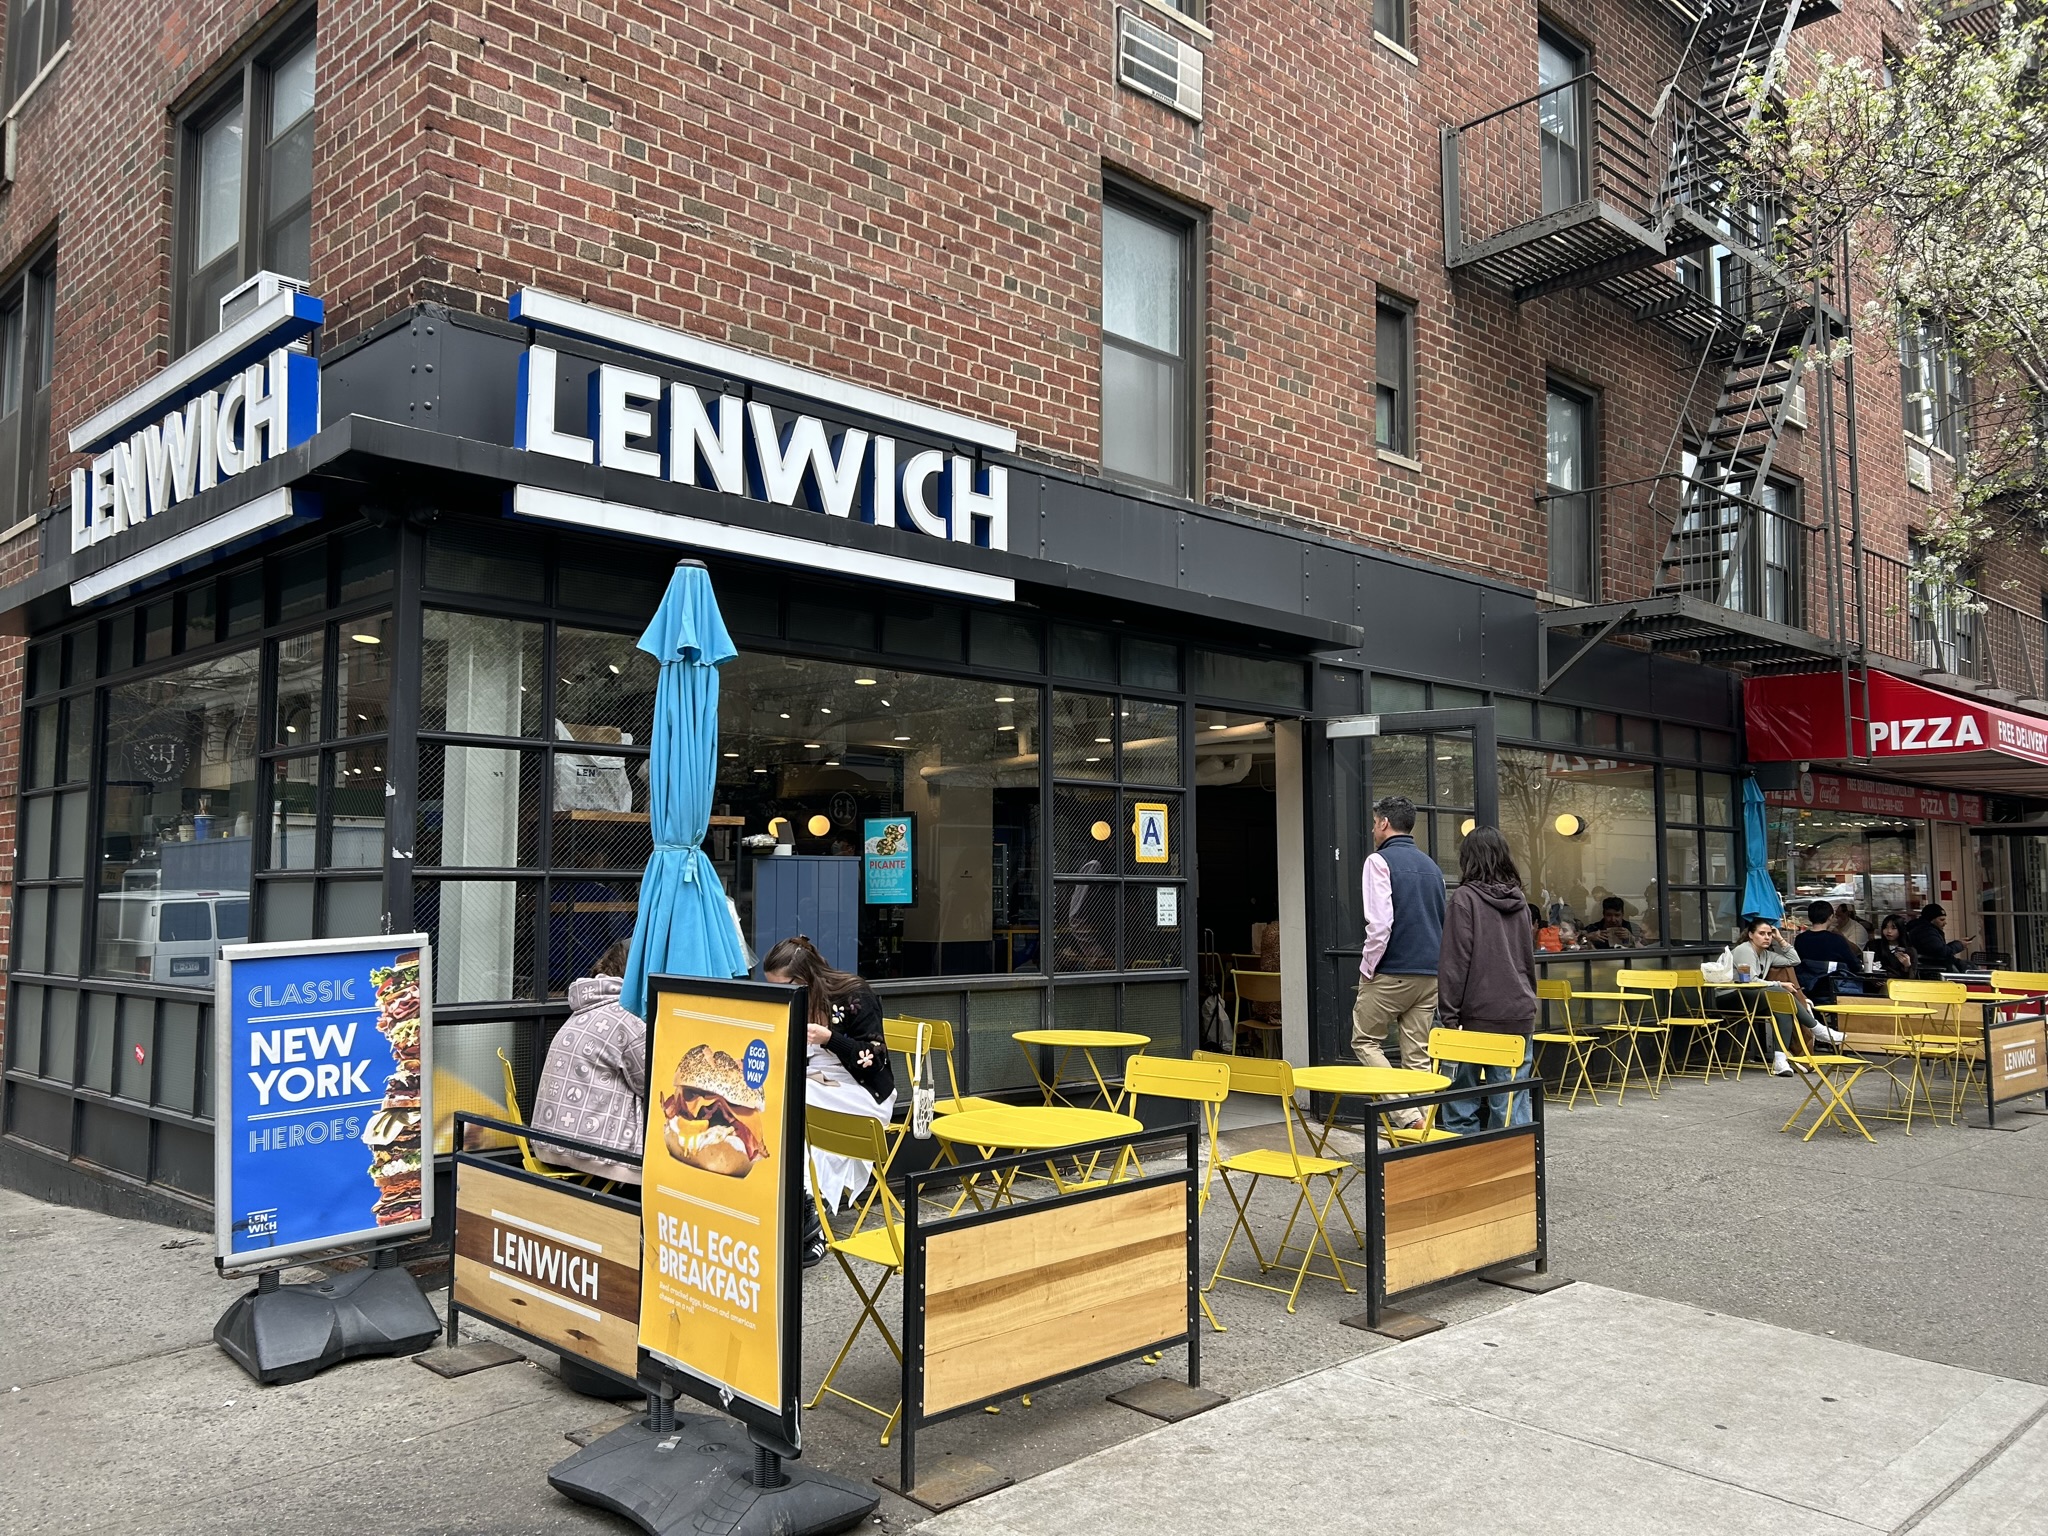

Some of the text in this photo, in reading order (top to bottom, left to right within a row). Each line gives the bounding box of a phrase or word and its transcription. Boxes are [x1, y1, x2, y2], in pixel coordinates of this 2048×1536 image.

[71, 348, 288, 554] LENWICH
[523, 344, 1008, 552] LENWICH
[1870, 715, 1983, 751] PIZZA
[1998, 720, 2048, 754] FREE DELIVERY
[1920, 797, 1945, 816] PIZZA
[1142, 816, 1161, 845] A
[869, 860, 906, 869] PICANTE
[869, 869, 904, 879] CAESAR
[869, 878, 898, 888] WRAP
[248, 978, 355, 1008] CLASSIC
[251, 1022, 358, 1067] NEW
[749, 1046, 766, 1059] EGGS
[747, 1058, 766, 1071] YOUR
[2004, 1048, 2036, 1072] LENWICH
[248, 1059, 372, 1106] YORK
[746, 1070, 763, 1083] WAY
[249, 1117, 360, 1153] HEROES
[248, 1221, 277, 1234] WICH
[658, 1211, 760, 1278] REAL EGGS
[493, 1227, 599, 1301] LENWICH
[659, 1244, 761, 1313] BREAKFAST
[658, 1292, 675, 1305] cheese
[659, 1281, 670, 1292] Real
[670, 1287, 689, 1301] cracked
[702, 1300, 719, 1315] bacon
[730, 1314, 757, 1330] american
